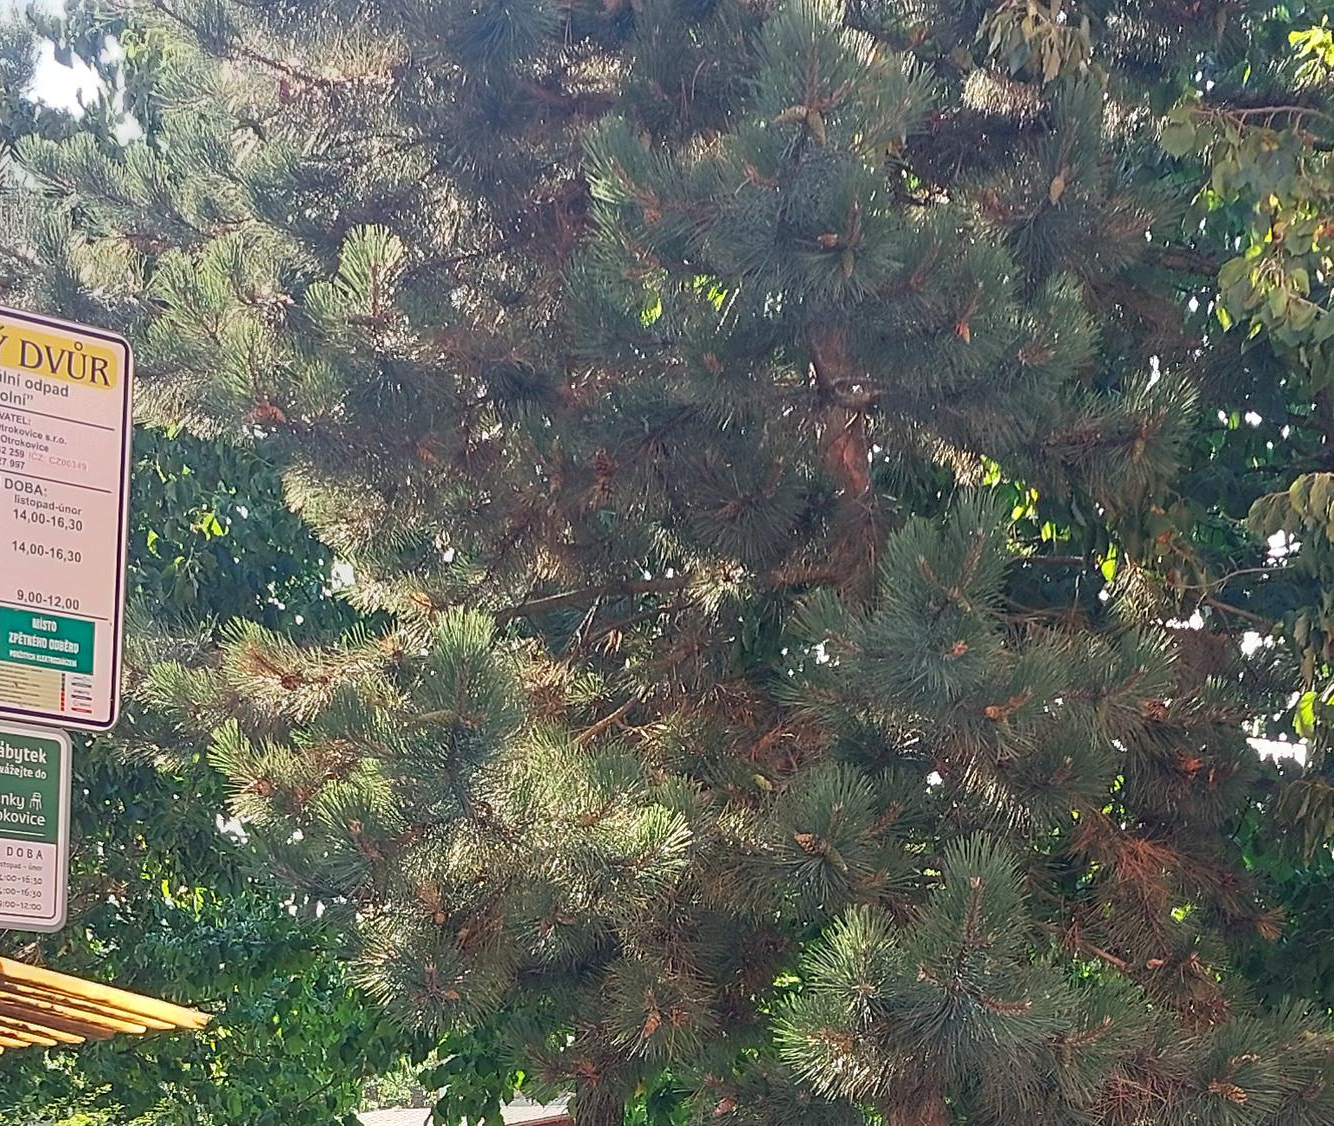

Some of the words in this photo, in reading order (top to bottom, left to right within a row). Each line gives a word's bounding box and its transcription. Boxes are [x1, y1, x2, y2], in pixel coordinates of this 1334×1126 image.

[19, 339, 112, 386] DVŮR
[25, 378, 69, 398] odpad
[0, 434, 49, 452] Otrokovice
[45, 434, 67, 445] s.r.o.
[9, 447, 25, 458] 259
[5, 478, 48, 497] DOBA:
[14, 494, 82, 516] listopad-únor
[13, 508, 83, 532] 14,00-16,30
[11, 540, 82, 563] 14,00-16,30
[31, 617, 58, 632] MÍSTO
[35, 767, 47, 779] do
[6, 846, 44, 860] DOBA
